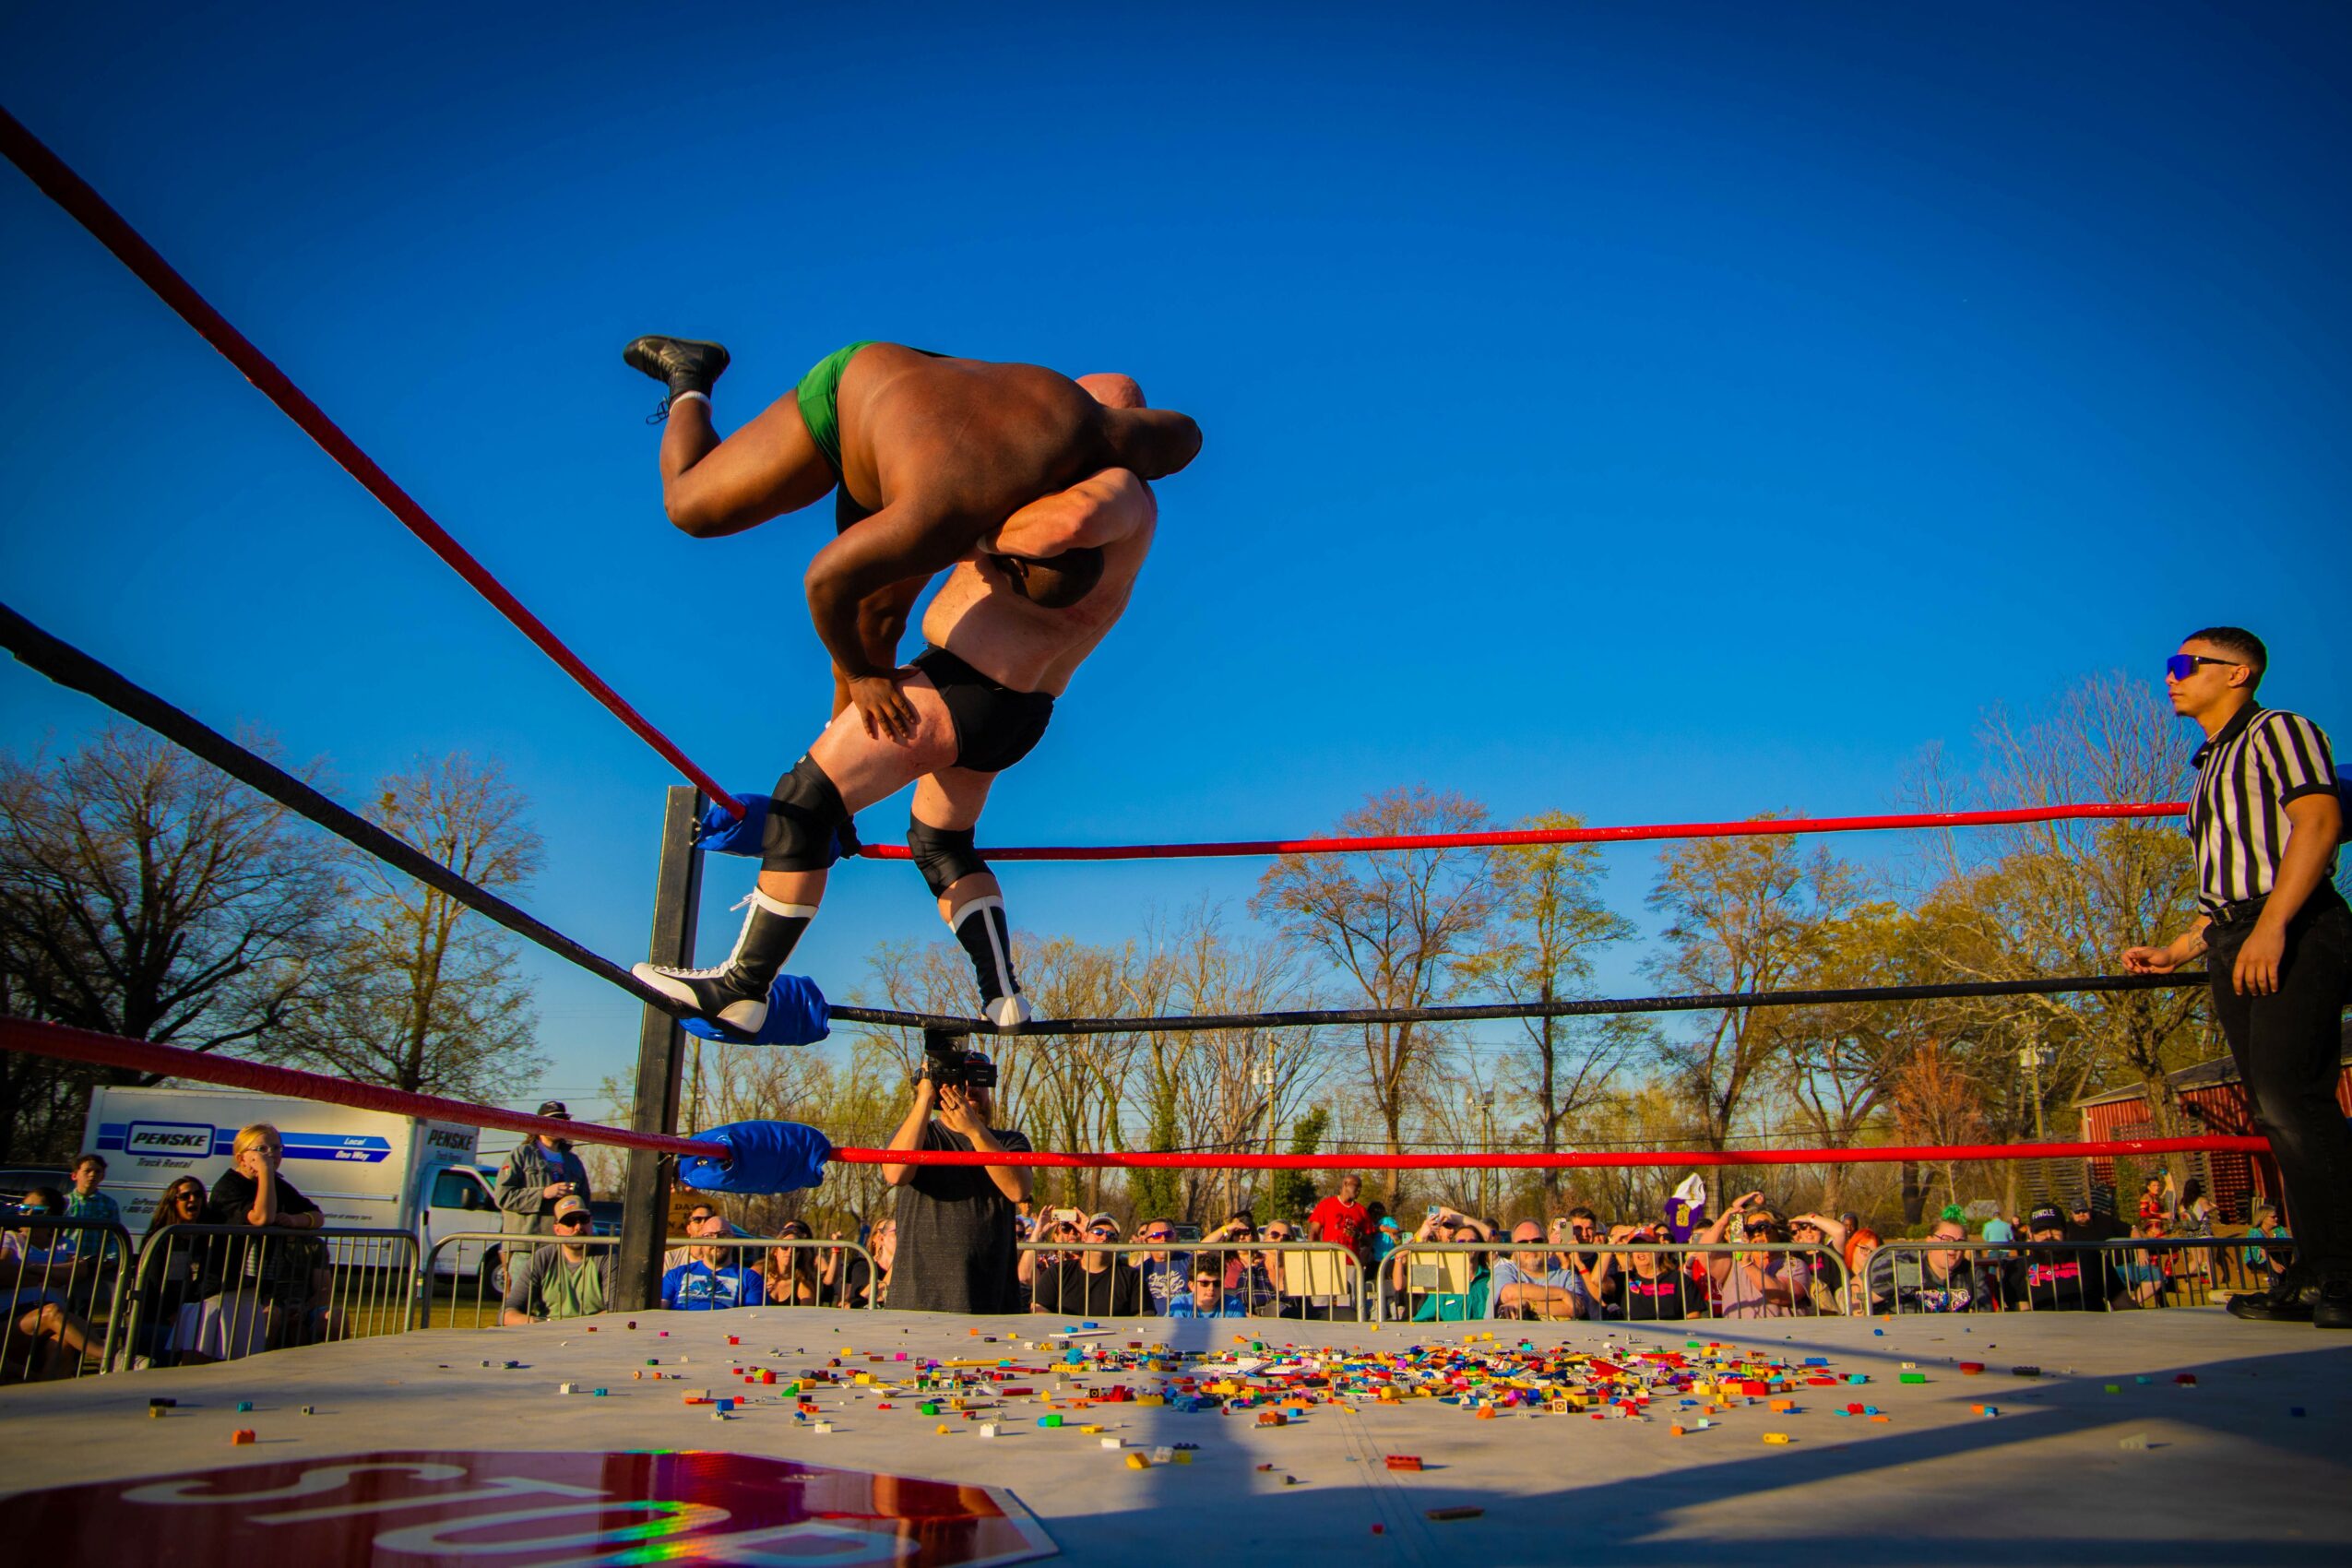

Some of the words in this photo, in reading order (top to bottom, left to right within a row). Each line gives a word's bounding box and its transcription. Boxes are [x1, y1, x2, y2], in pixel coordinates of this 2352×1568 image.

[133, 1132, 208, 1146] PENSKE
[343, 1137, 367, 1146] Local
[428, 1129, 474, 1151] PENSKE
[335, 1150, 350, 1159] One
[351, 1151, 371, 1161] Way
[137, 1158, 162, 1167] Truck
[162, 1158, 193, 1169] Rental
[120, 1462, 921, 1568] STOP
